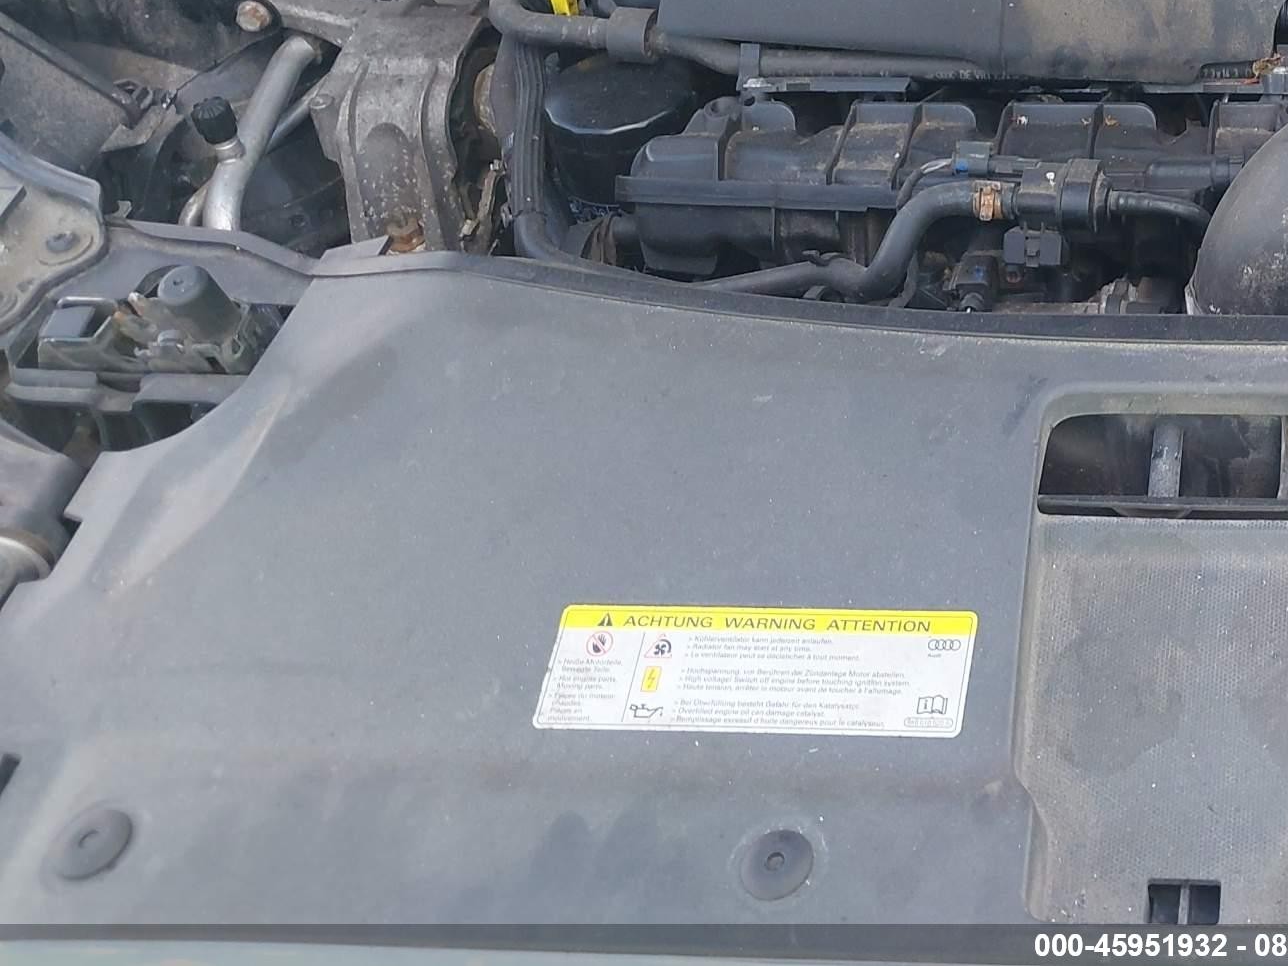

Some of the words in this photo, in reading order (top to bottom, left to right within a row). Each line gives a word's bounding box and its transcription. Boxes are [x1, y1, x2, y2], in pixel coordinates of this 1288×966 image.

[623, 616, 713, 628] ACHTUNG
[725, 618, 816, 630] WARNING
[827, 620, 931, 632] ATTENTION
